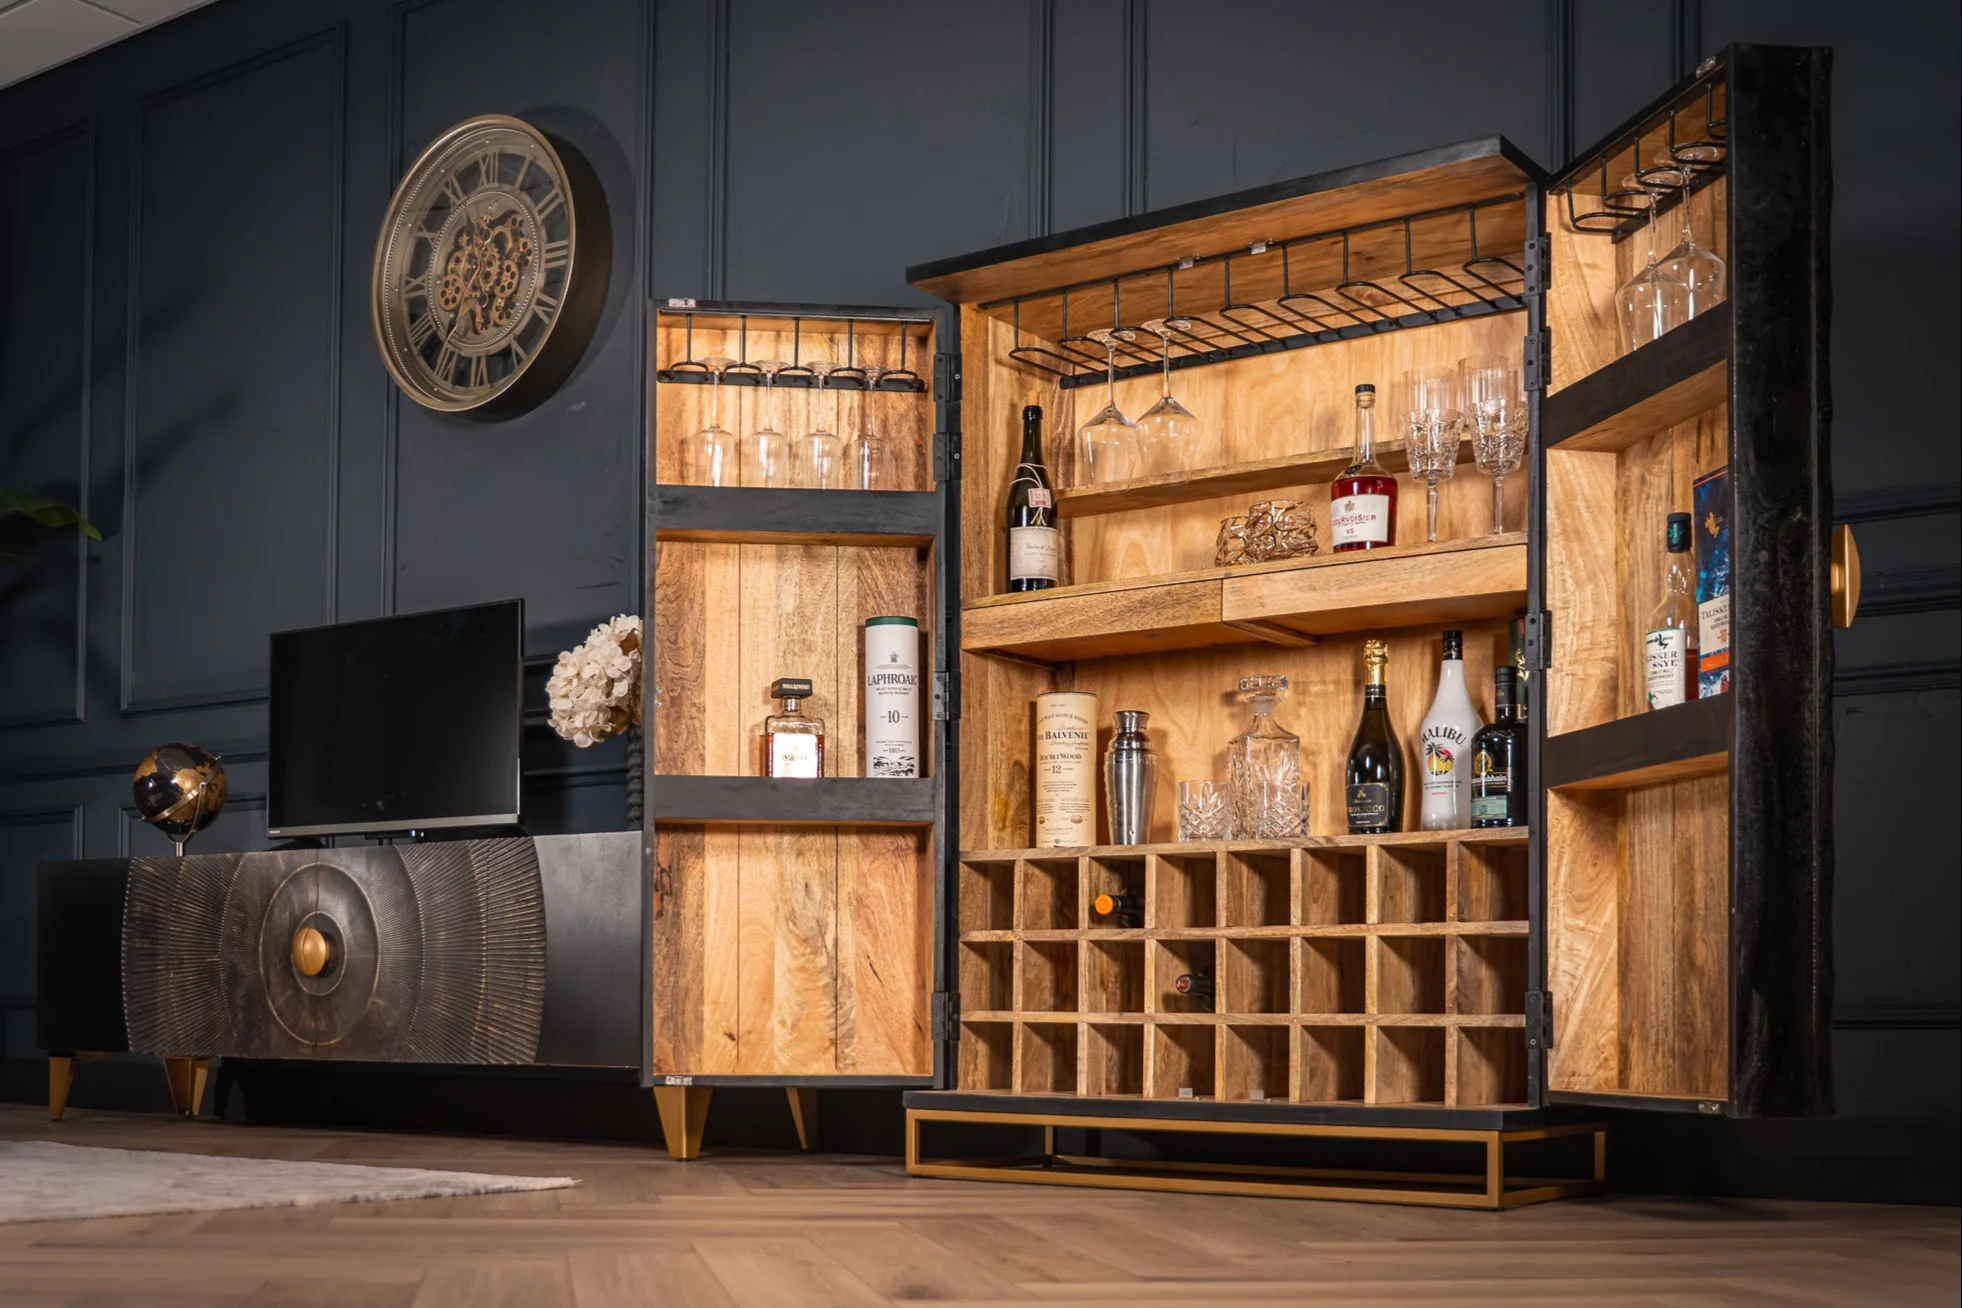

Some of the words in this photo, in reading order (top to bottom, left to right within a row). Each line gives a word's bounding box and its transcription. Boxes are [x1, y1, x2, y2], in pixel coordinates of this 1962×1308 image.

[1701, 605, 1728, 620] TALISKE
[1646, 651, 1677, 662] LISKER
[1652, 659, 1678, 668] SKYE
[888, 710, 900, 723] 10
[1045, 731, 1089, 740] BALVENIE
[1052, 765, 1062, 773] 12
